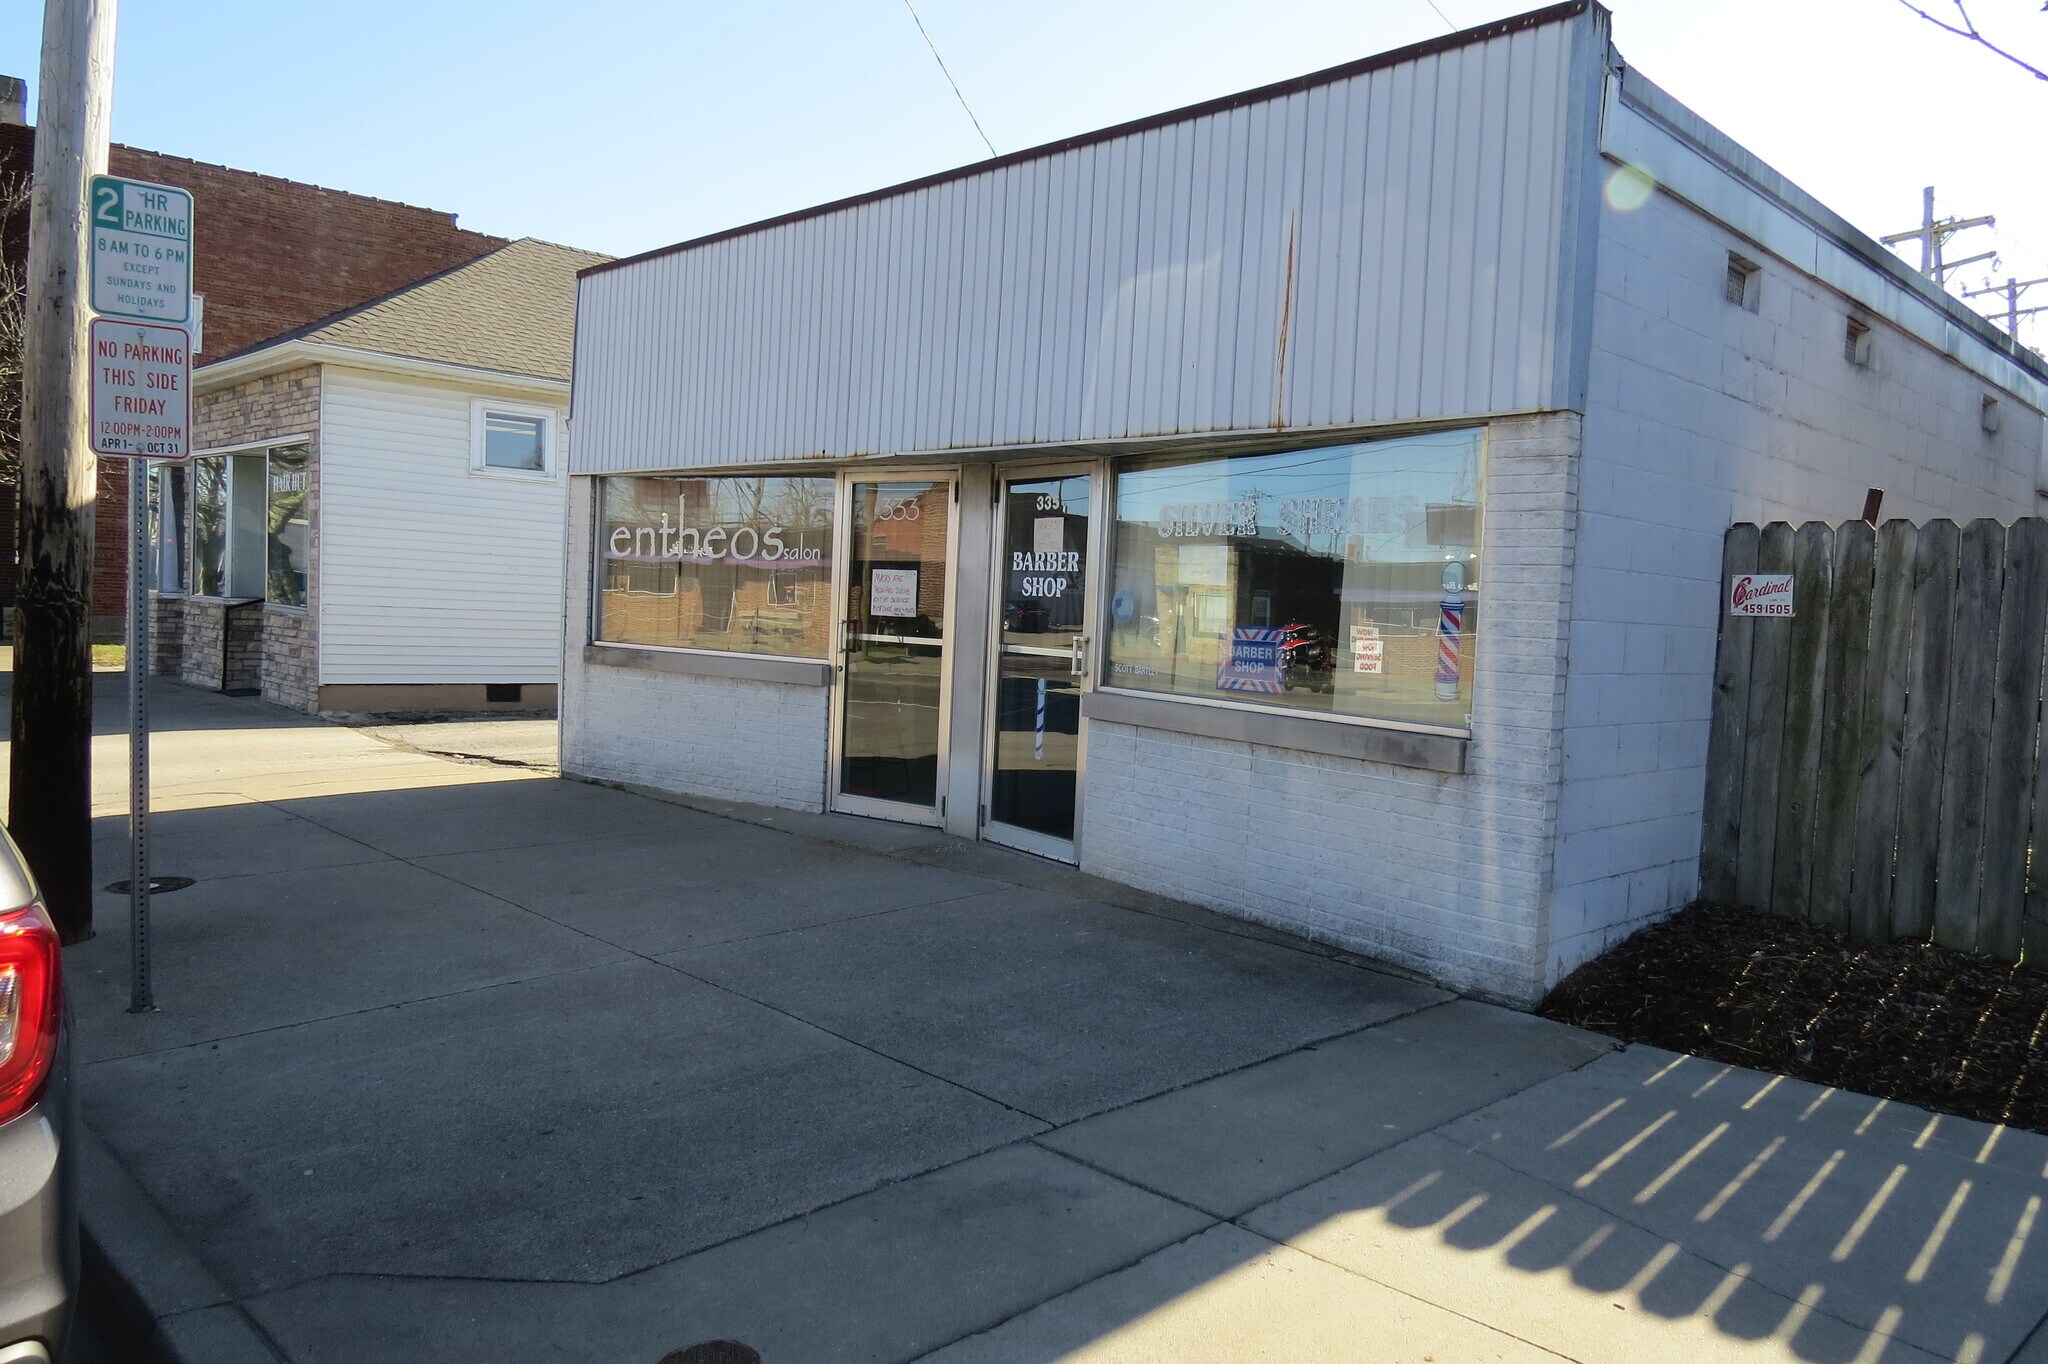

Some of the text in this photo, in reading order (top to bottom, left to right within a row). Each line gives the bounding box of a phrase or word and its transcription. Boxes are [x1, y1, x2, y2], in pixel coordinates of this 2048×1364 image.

[96, 187, 168, 222] 2 HR
[125, 210, 186, 236] PARKING
[98, 238, 185, 263] 8 AM TO 6 PM
[124, 262, 160, 275] EXCEPT
[106, 276, 176, 294] SUNDAYS AND
[118, 294, 166, 309] HOLIDAYS
[98, 340, 182, 365] NO PARKING
[103, 367, 178, 391] THIS SIDE
[114, 395, 166, 416] FRIDAY
[101, 438, 120, 449] APR
[147, 442, 165, 453] OCT
[167, 443, 179, 454] 31
[273, 474, 291, 493] HAIR
[880, 497, 920, 521] 333
[1157, 496, 1418, 538] SILVER SHEARS
[783, 532, 821, 560] salon
[1012, 551, 1079, 572] BARBER
[1021, 576, 1067, 598] SHOP
[1733, 576, 1792, 608] Cardinal
[1230, 645, 1273, 660] BARBER
[1114, 663, 1133, 674] SCOTT
[1234, 661, 1265, 675] SHOP
